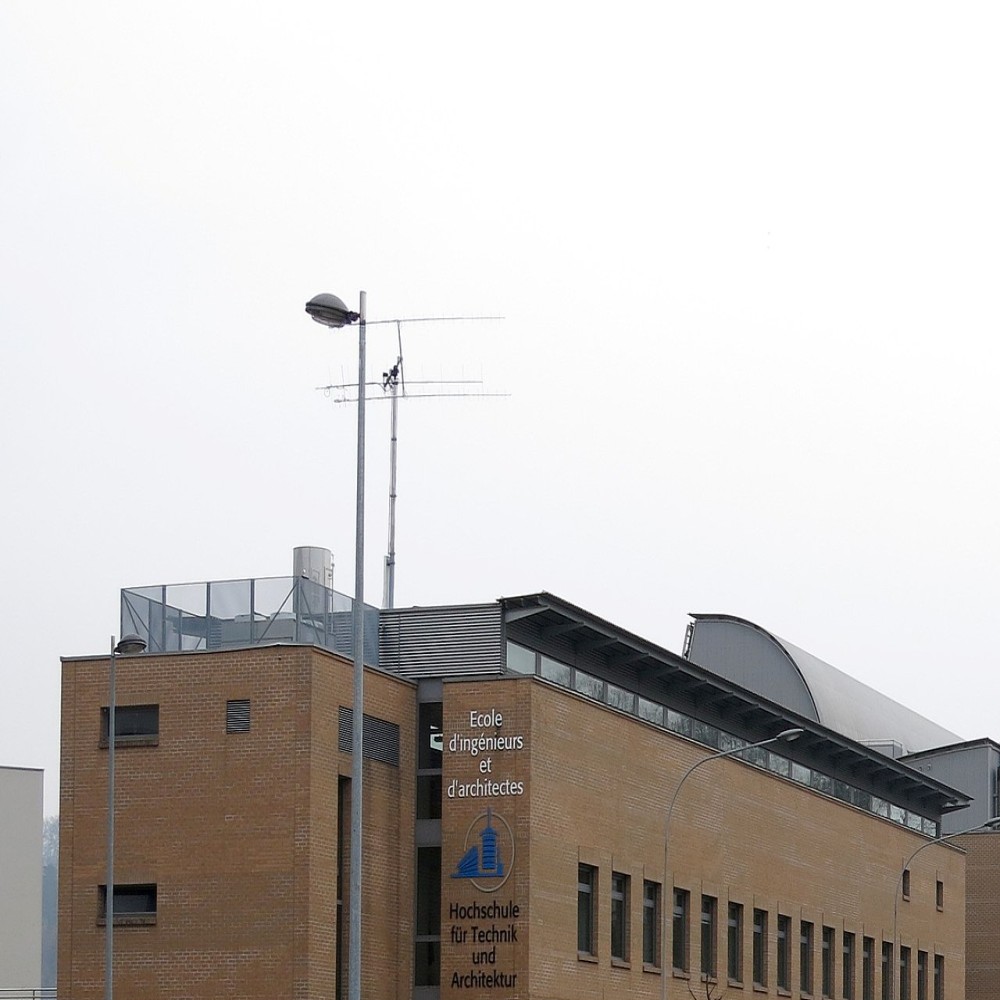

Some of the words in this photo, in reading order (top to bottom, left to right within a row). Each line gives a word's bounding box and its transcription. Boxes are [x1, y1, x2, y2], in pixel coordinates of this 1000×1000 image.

[470, 708, 503, 727] Ecole
[448, 732, 524, 756] d'ingénieurs
[479, 757, 492, 773] et
[447, 778, 524, 798] d'architectes
[449, 900, 520, 919] Hochschule
[451, 925, 467, 943] für
[471, 924, 518, 943] Technik
[472, 945, 496, 964] und
[451, 969, 517, 988] Architektur
